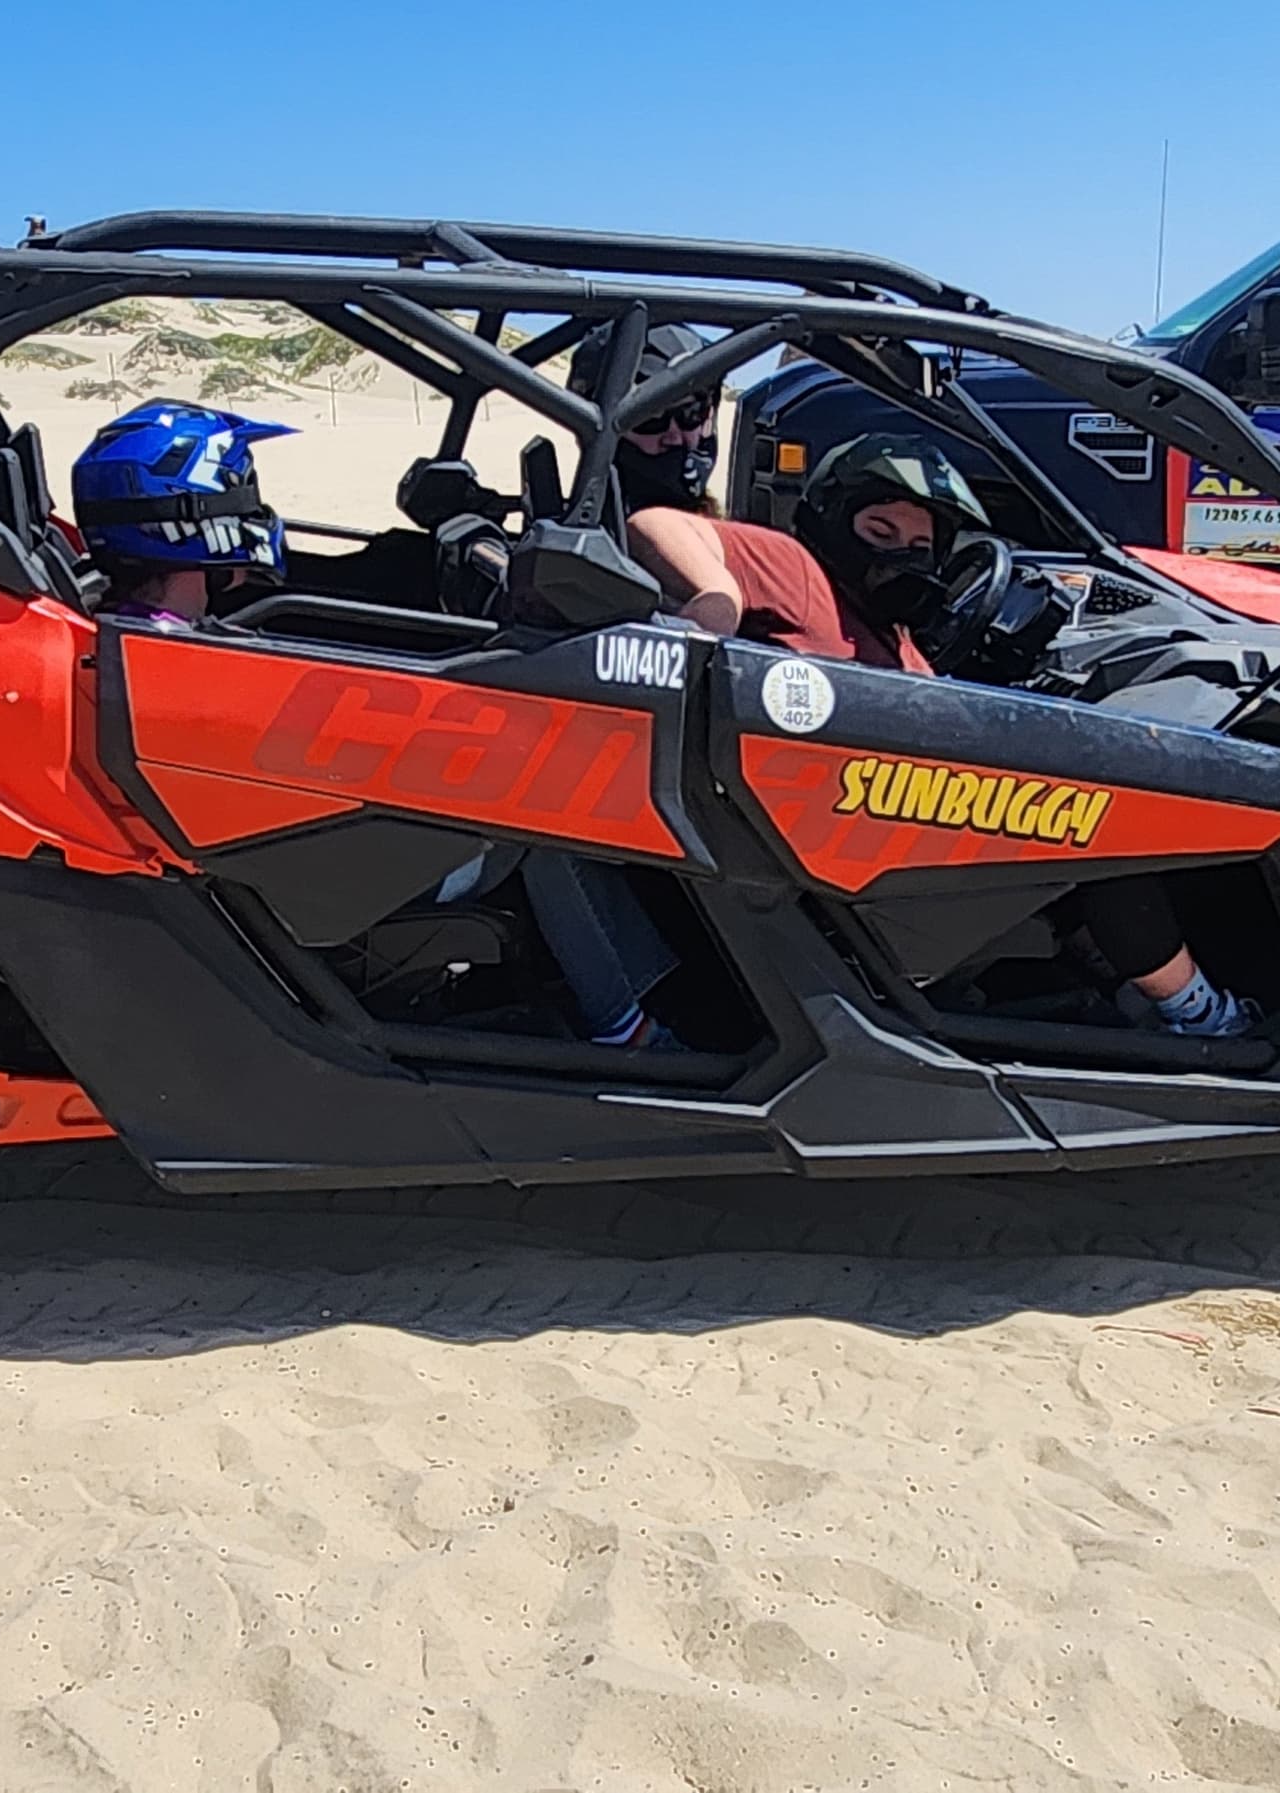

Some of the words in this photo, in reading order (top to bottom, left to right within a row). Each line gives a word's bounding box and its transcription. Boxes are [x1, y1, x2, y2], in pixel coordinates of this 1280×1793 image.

[596, 634, 687, 689] UM402
[783, 666, 809, 680] UM
[783, 711, 813, 726] 402
[836, 757, 1112, 845] SUNBUGGY
